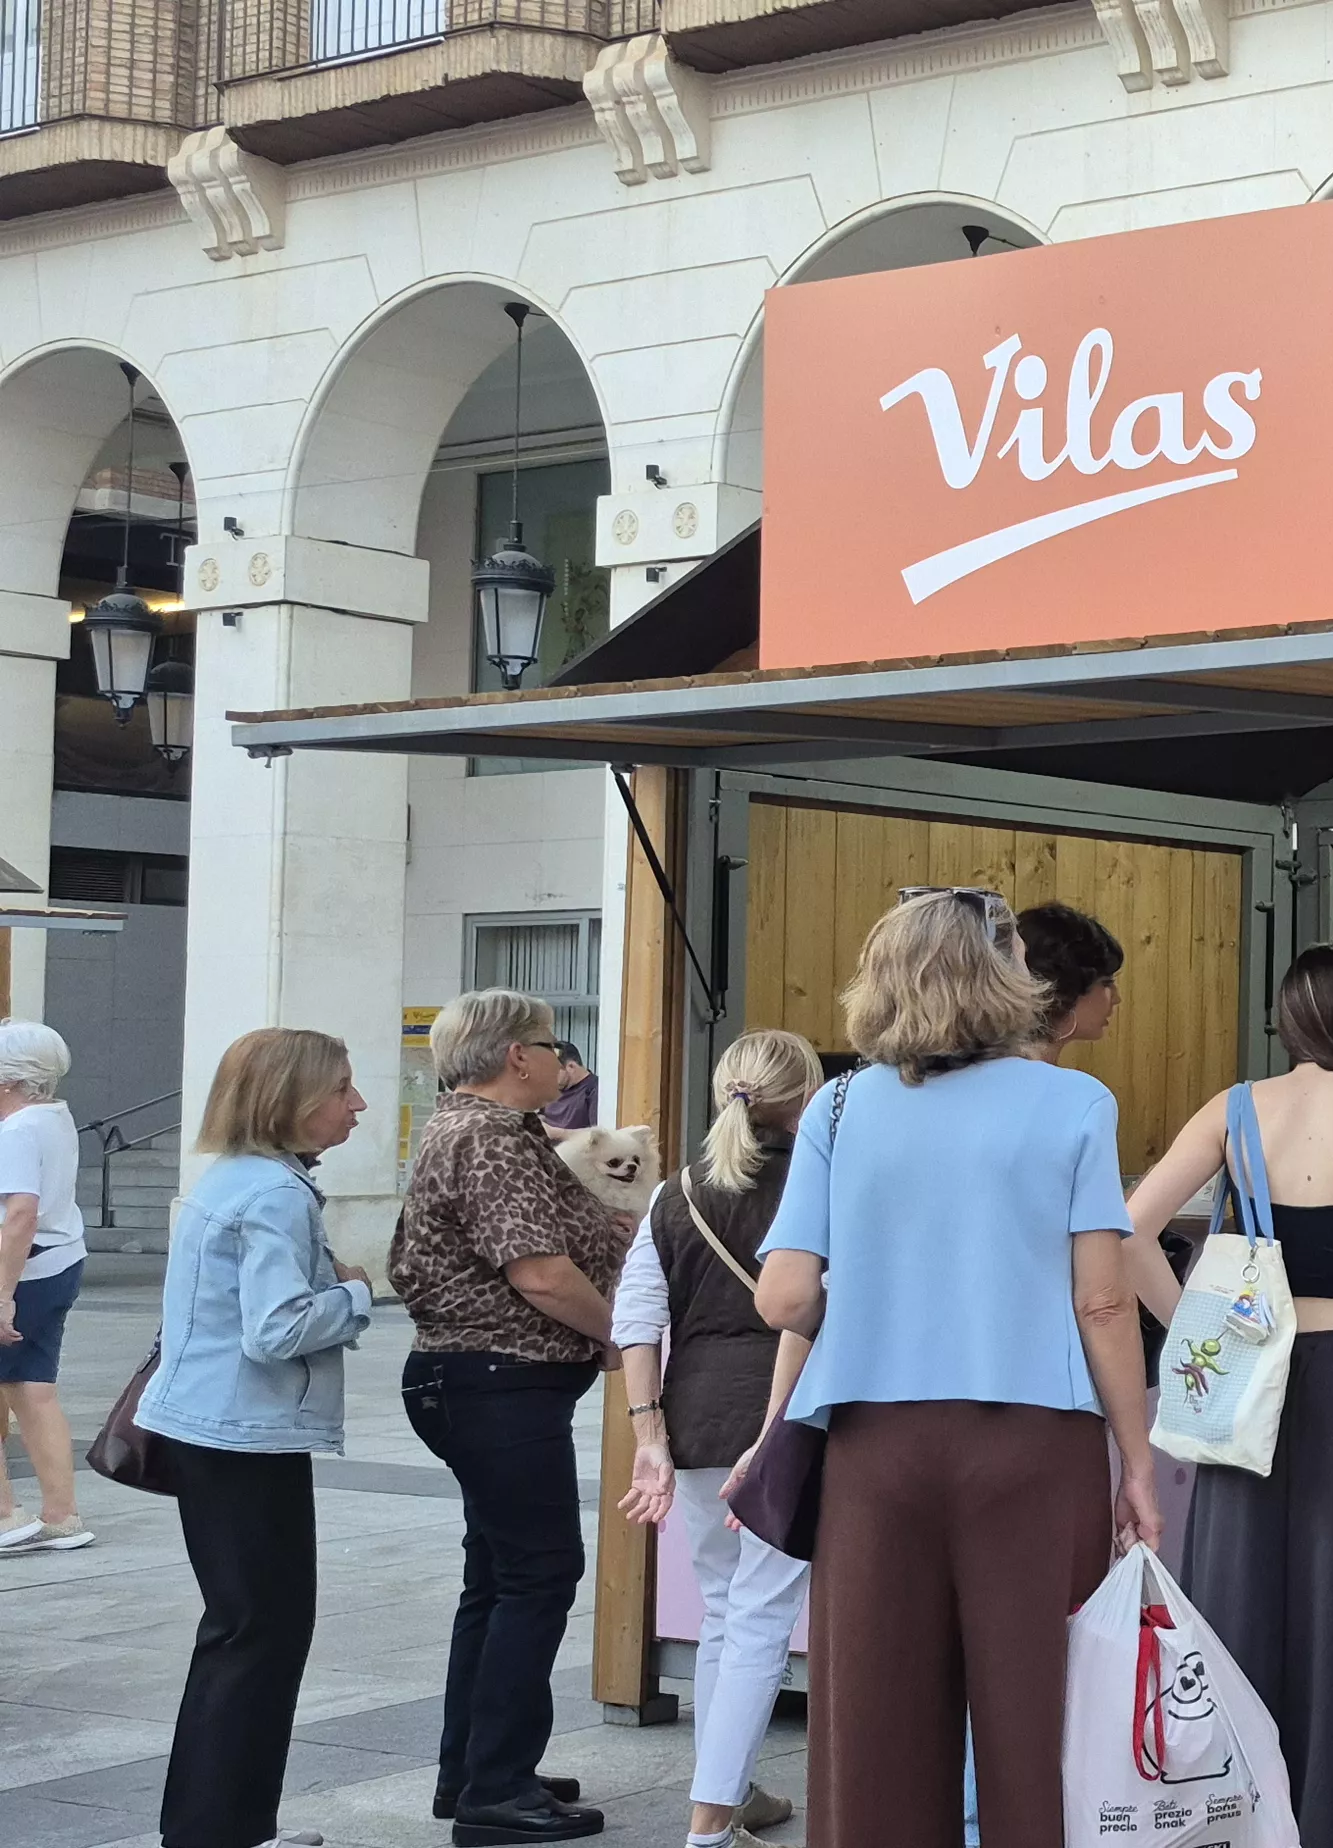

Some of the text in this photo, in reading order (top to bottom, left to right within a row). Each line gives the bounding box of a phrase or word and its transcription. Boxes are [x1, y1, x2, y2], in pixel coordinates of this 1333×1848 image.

[880, 328, 1263, 489] Vilas
[1154, 1807, 1193, 1821] prezio
[1207, 1802, 1237, 1814] bons
[1154, 1818, 1187, 1830] onak
[1207, 1811, 1242, 1825] preus
[1100, 1823, 1138, 1835] precio
